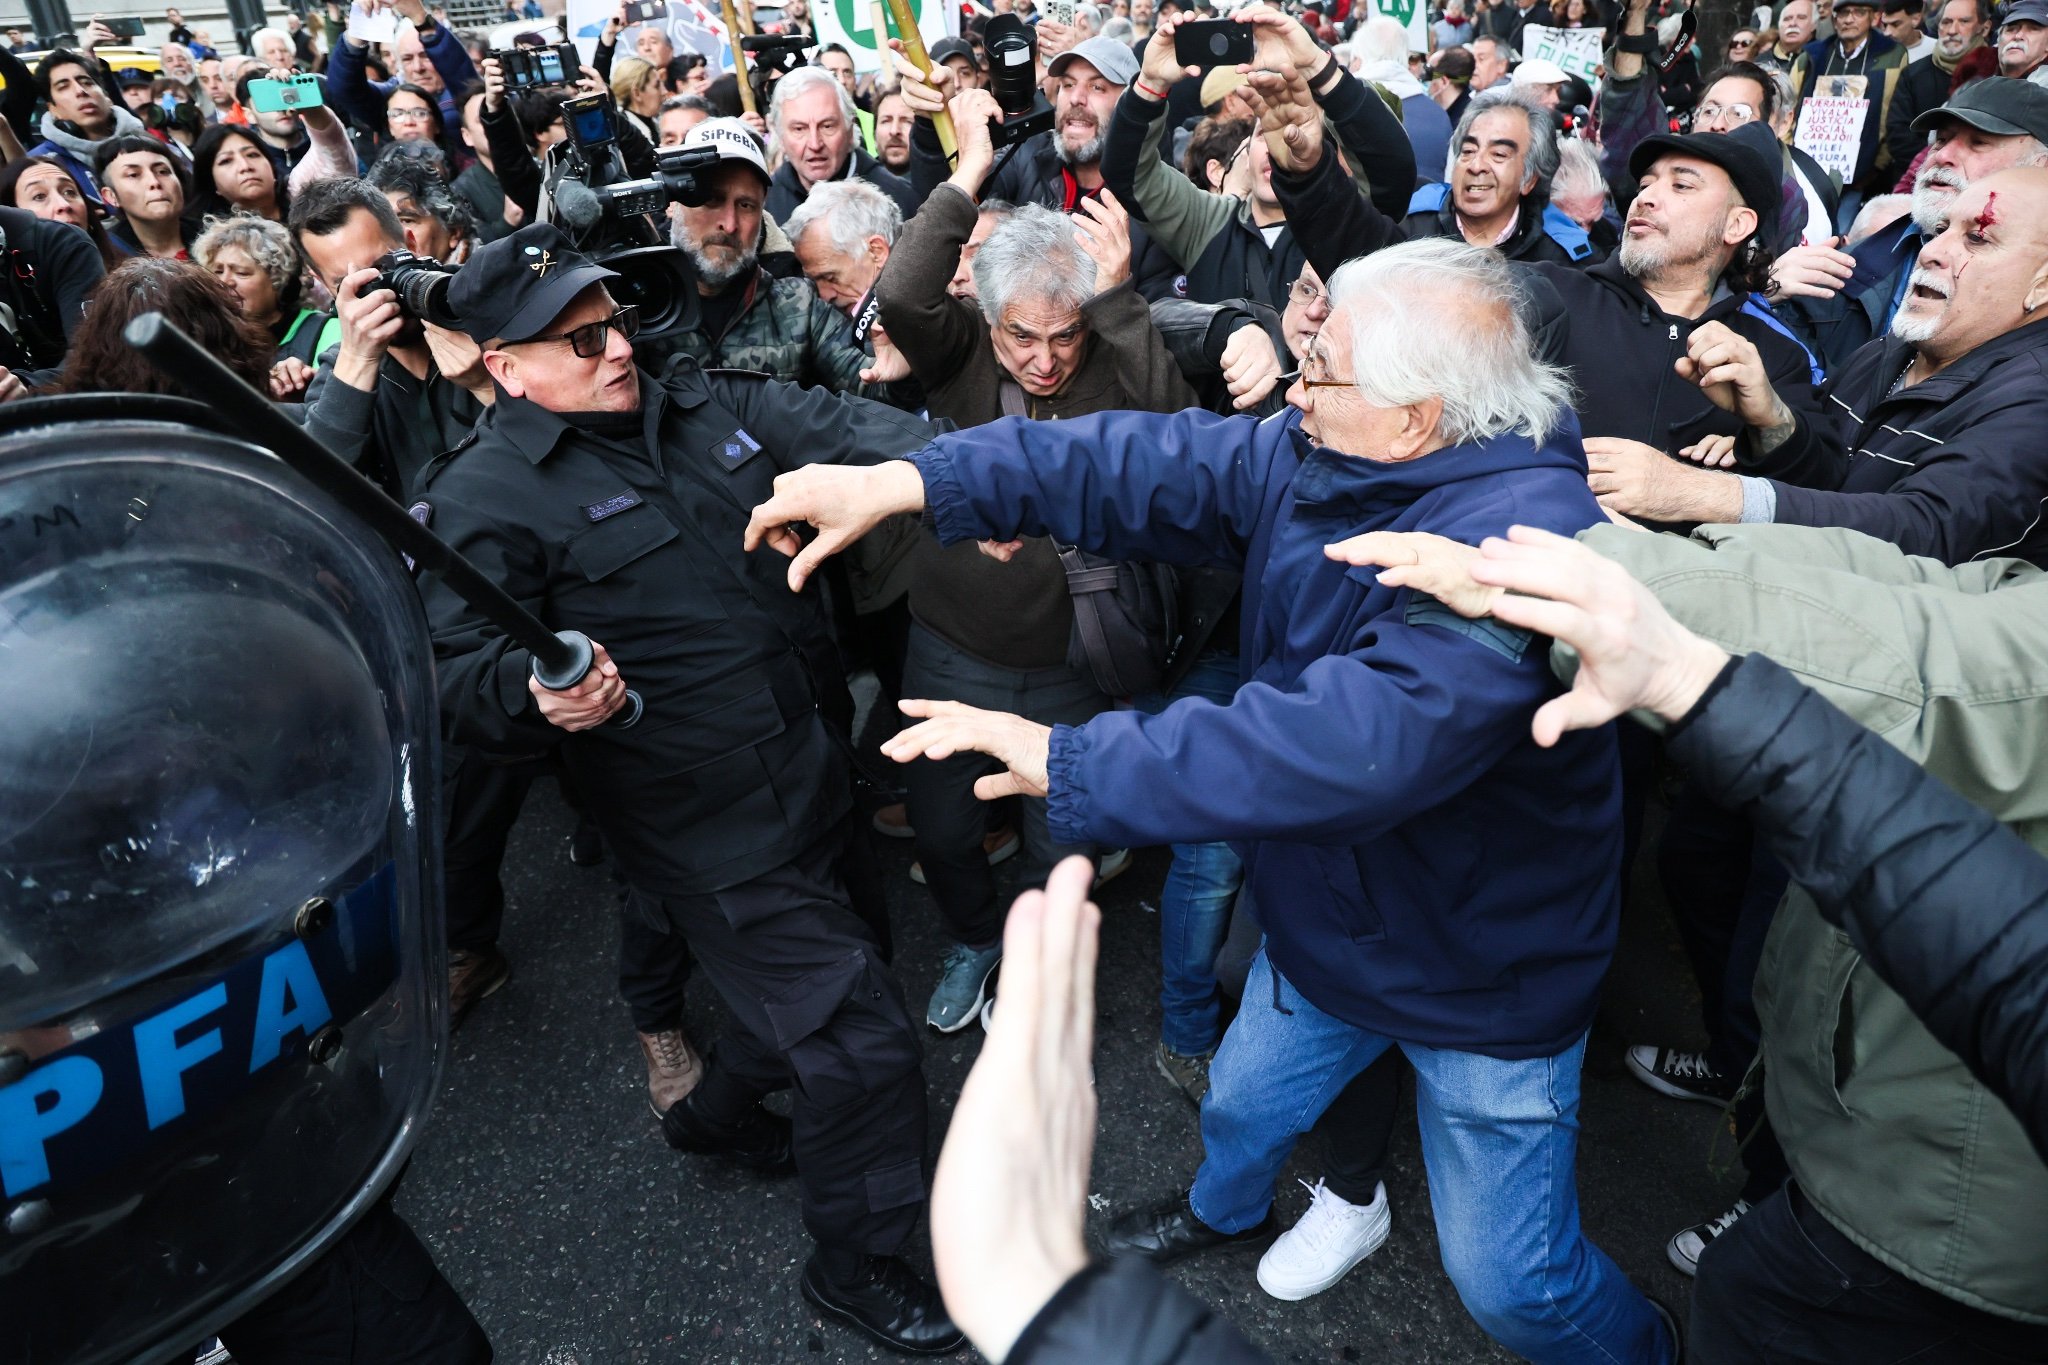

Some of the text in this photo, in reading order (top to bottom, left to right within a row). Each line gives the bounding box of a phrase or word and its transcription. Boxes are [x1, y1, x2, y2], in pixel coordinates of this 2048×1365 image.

[1806, 116, 1854, 124] JUSTICIA
[1809, 125, 1846, 133] SOCIAL
[701, 128, 758, 154] SiPreBA
[1807, 144, 1842, 152] MILEI
[1810, 154, 1847, 162] ASURA
[612, 190, 632, 198] SONY
[604, 495, 628, 508] LOPEZ
[0, 938, 333, 1199] PFA
